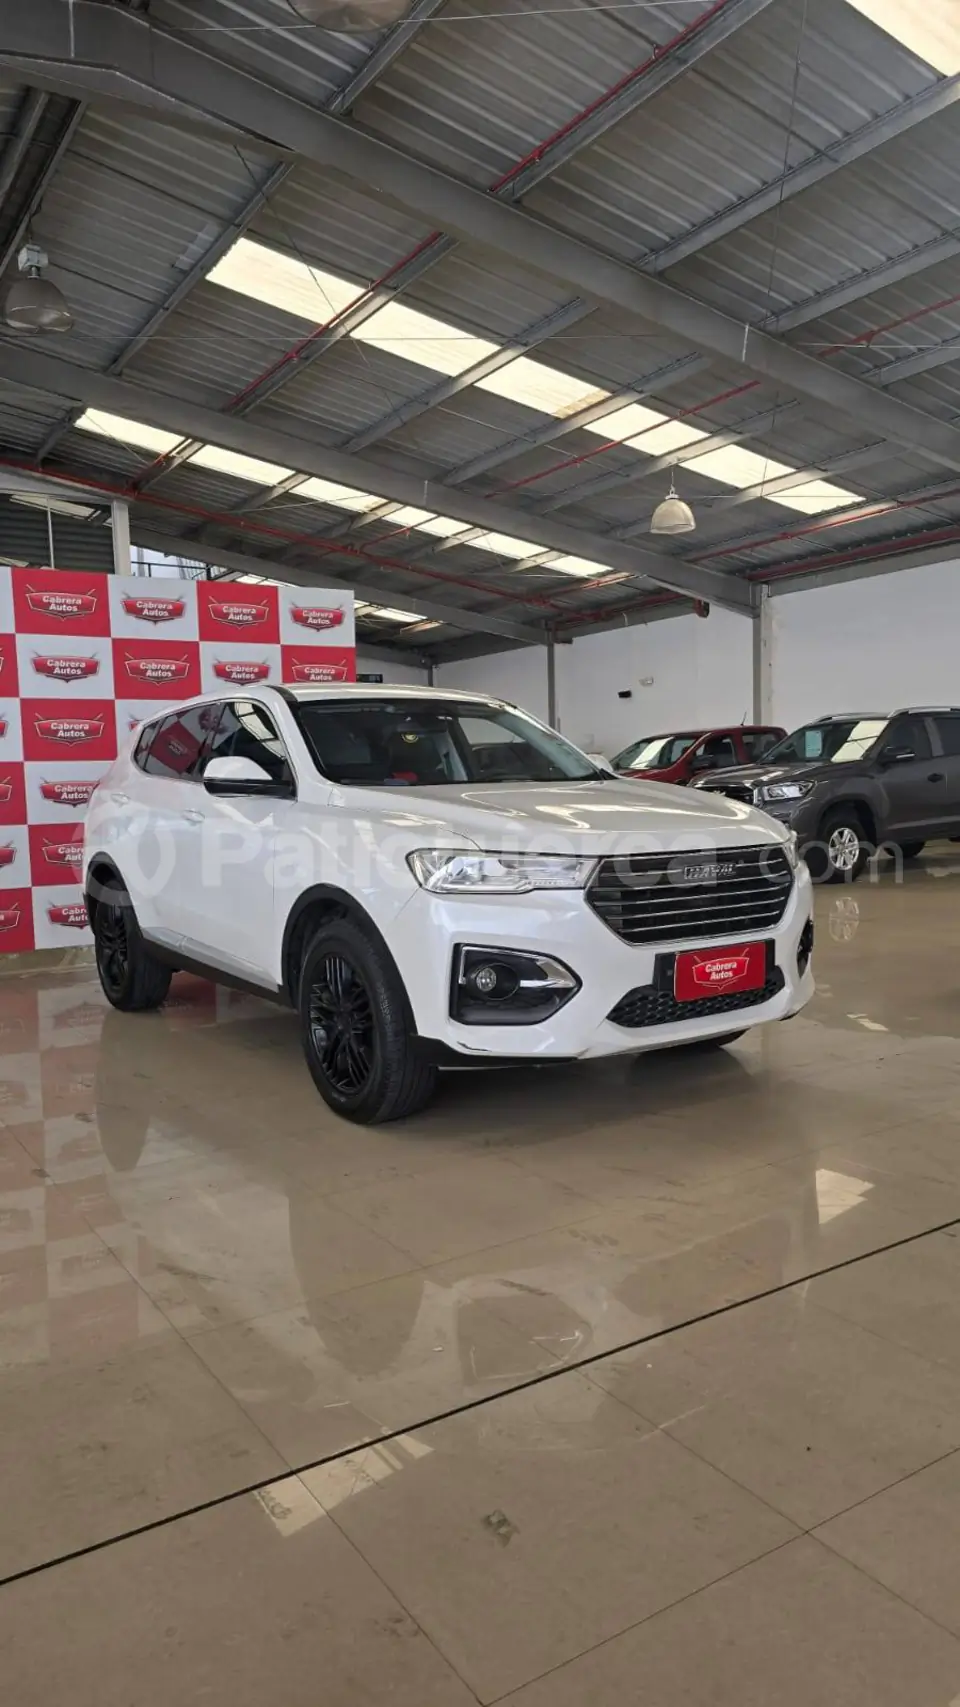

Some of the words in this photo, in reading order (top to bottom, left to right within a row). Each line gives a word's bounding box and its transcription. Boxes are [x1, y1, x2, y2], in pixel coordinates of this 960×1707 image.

[42, 595, 82, 605] Cabrera
[49, 603, 78, 612] Autos
[136, 601, 173, 610] Cabrera
[222, 605, 257, 614] Cabrera
[142, 608, 169, 617] Autos
[227, 613, 253, 621] Autos
[302, 610, 334, 619] Cabrera
[306, 617, 331, 625] Autos
[46, 659, 86, 668] Cabrera
[140, 662, 176, 671] Cabrera
[53, 666, 82, 675] Autos
[146, 669, 172, 677] Autos
[225, 664, 259, 673] Cabrera
[304, 666, 336, 675] Cabrera
[231, 671, 255, 680] Autos
[309, 673, 332, 682] Autos
[50, 722, 90, 731] Cabrera
[57, 729, 86, 738] Autos
[60, 792, 89, 800] Autos
[65, 853, 84, 861] Aut
[705, 961, 738, 973] Cabrera
[709, 970, 734, 981] Autos
